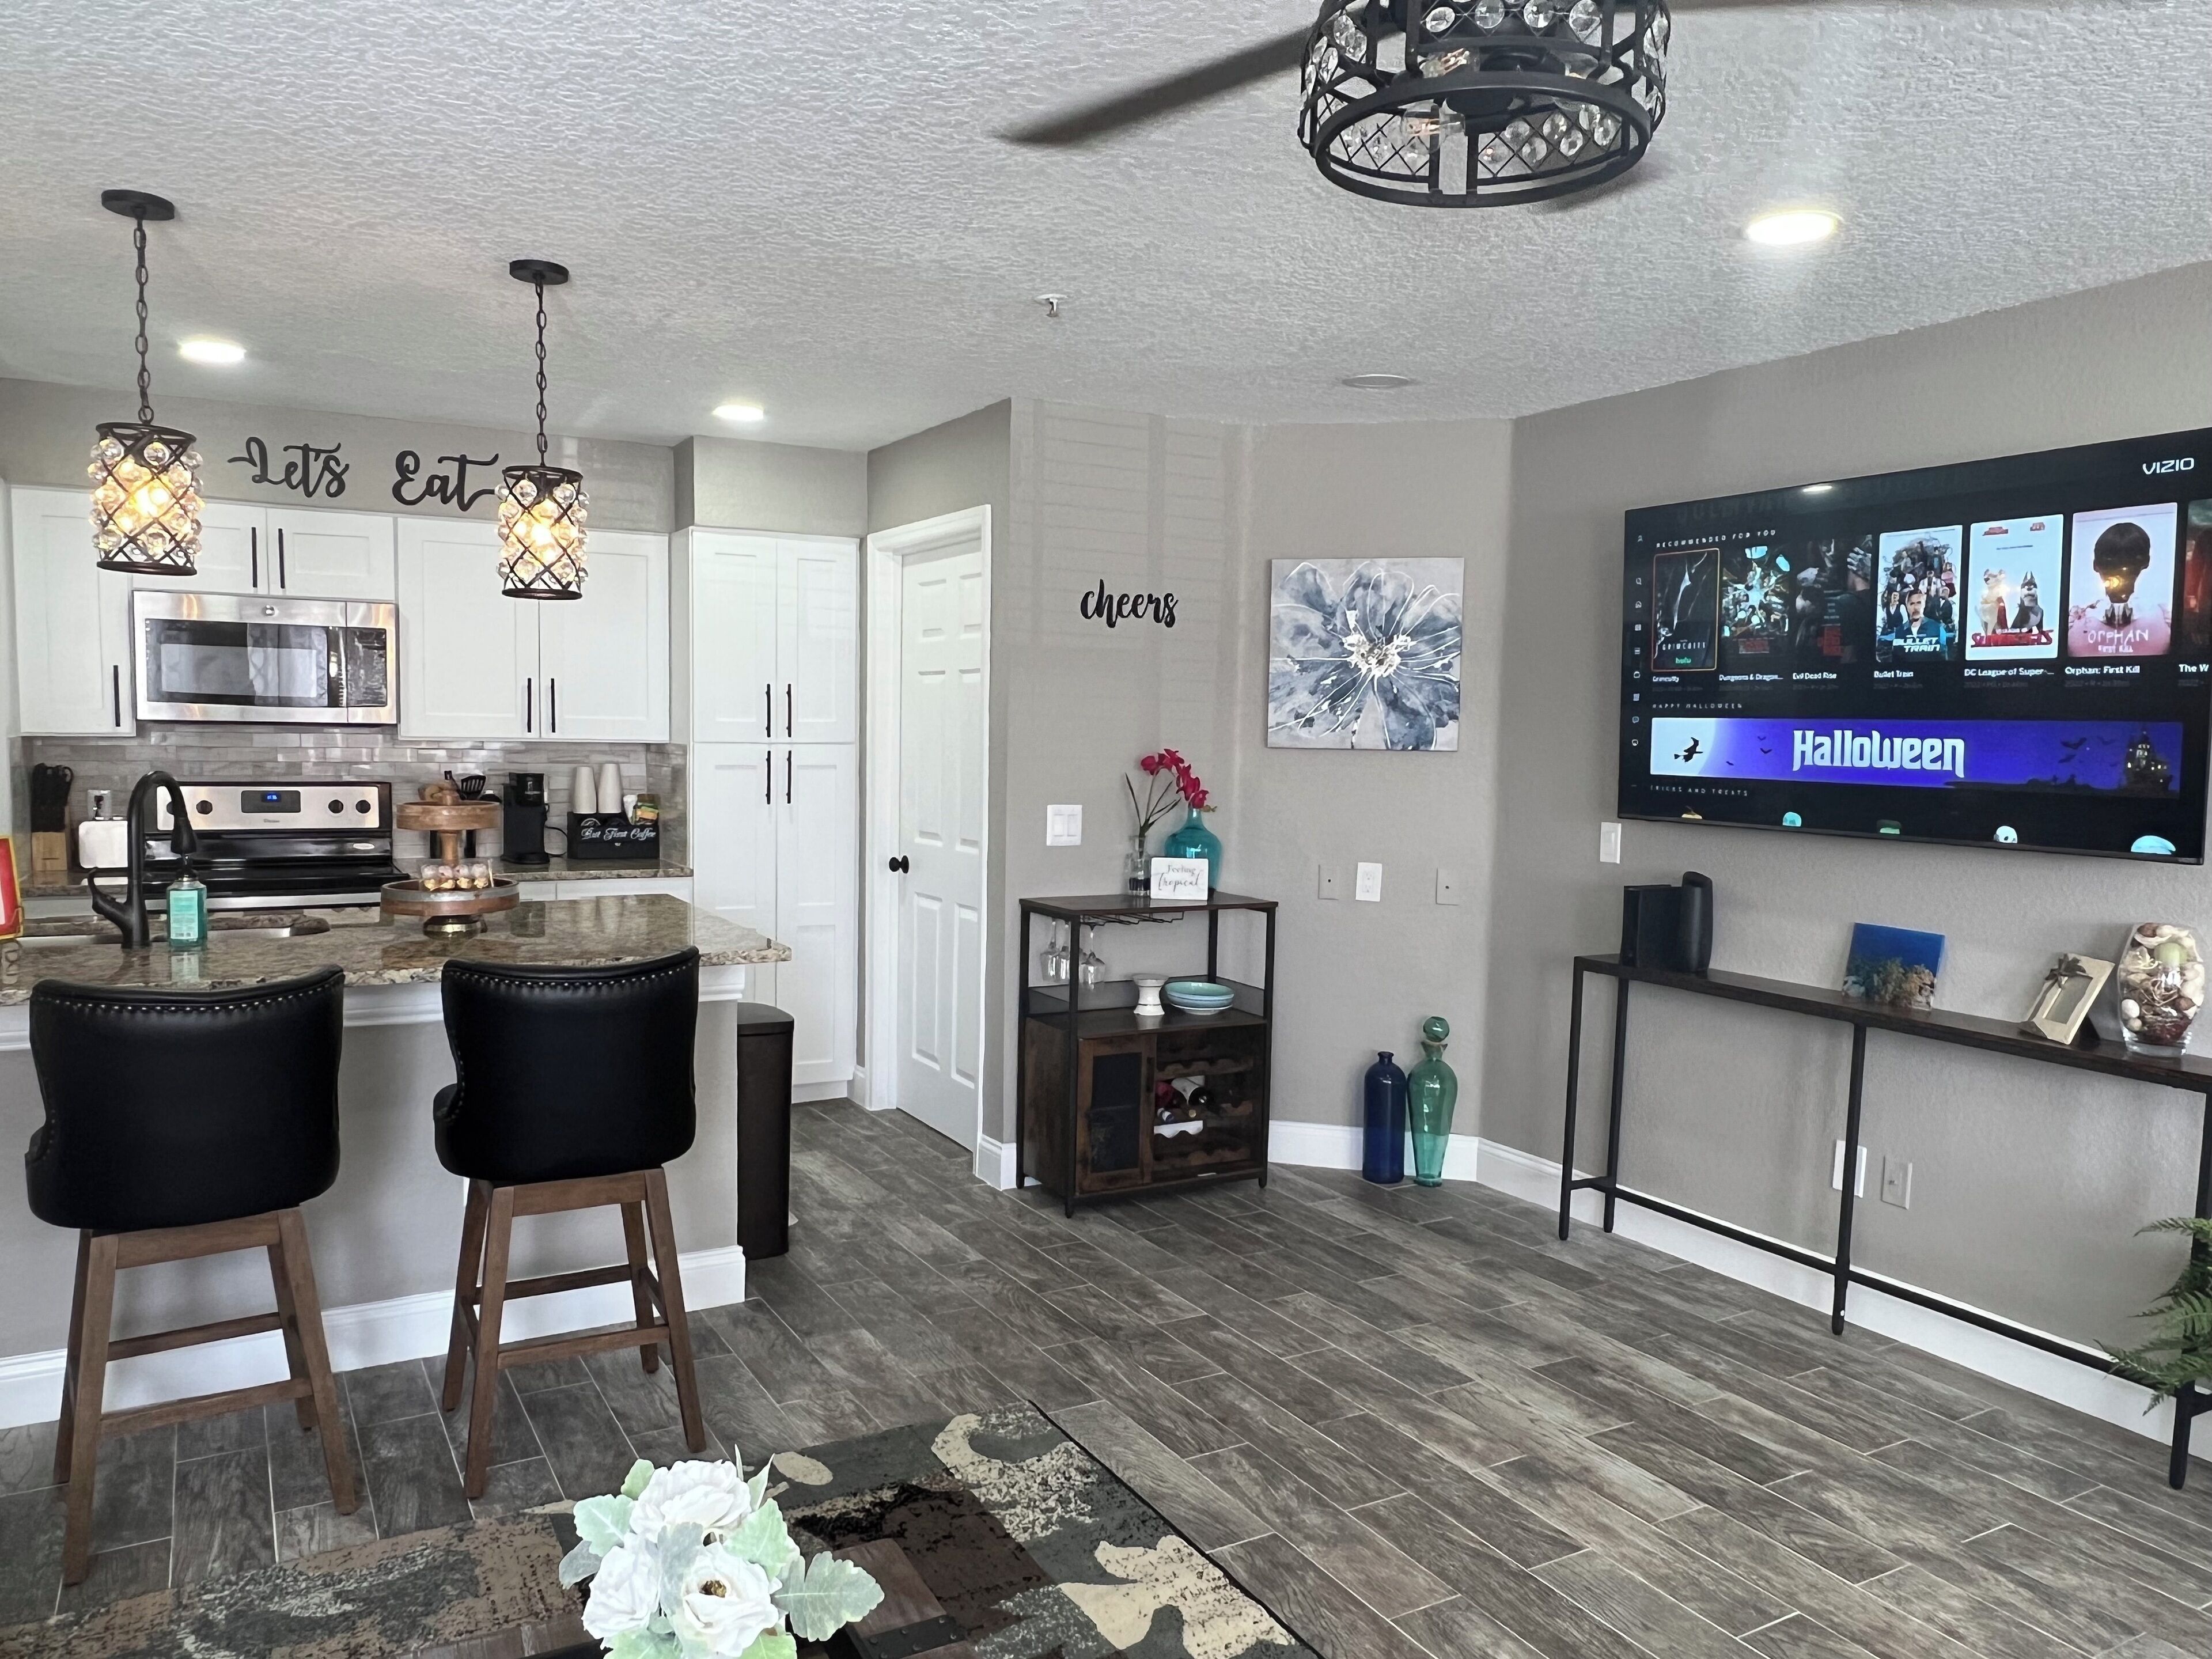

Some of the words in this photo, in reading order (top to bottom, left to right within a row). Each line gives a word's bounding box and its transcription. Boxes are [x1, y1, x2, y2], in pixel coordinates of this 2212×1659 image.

[2142, 457, 2195, 475] VIZIO
[228, 437, 349, 498] Let's
[392, 453, 497, 512] Eat
[1080, 578, 1179, 628] cheers
[2087, 629, 2149, 645] ORPHAN
[1904, 644, 1941, 653] TRAIN
[1964, 668, 1977, 676] DC
[1978, 668, 2007, 677] League
[2008, 668, 2017, 676] of
[2103, 665, 2124, 674] First
[2125, 665, 2141, 673] Kill
[2179, 664, 2198, 673] The
[1792, 729, 1965, 778] Halloween
